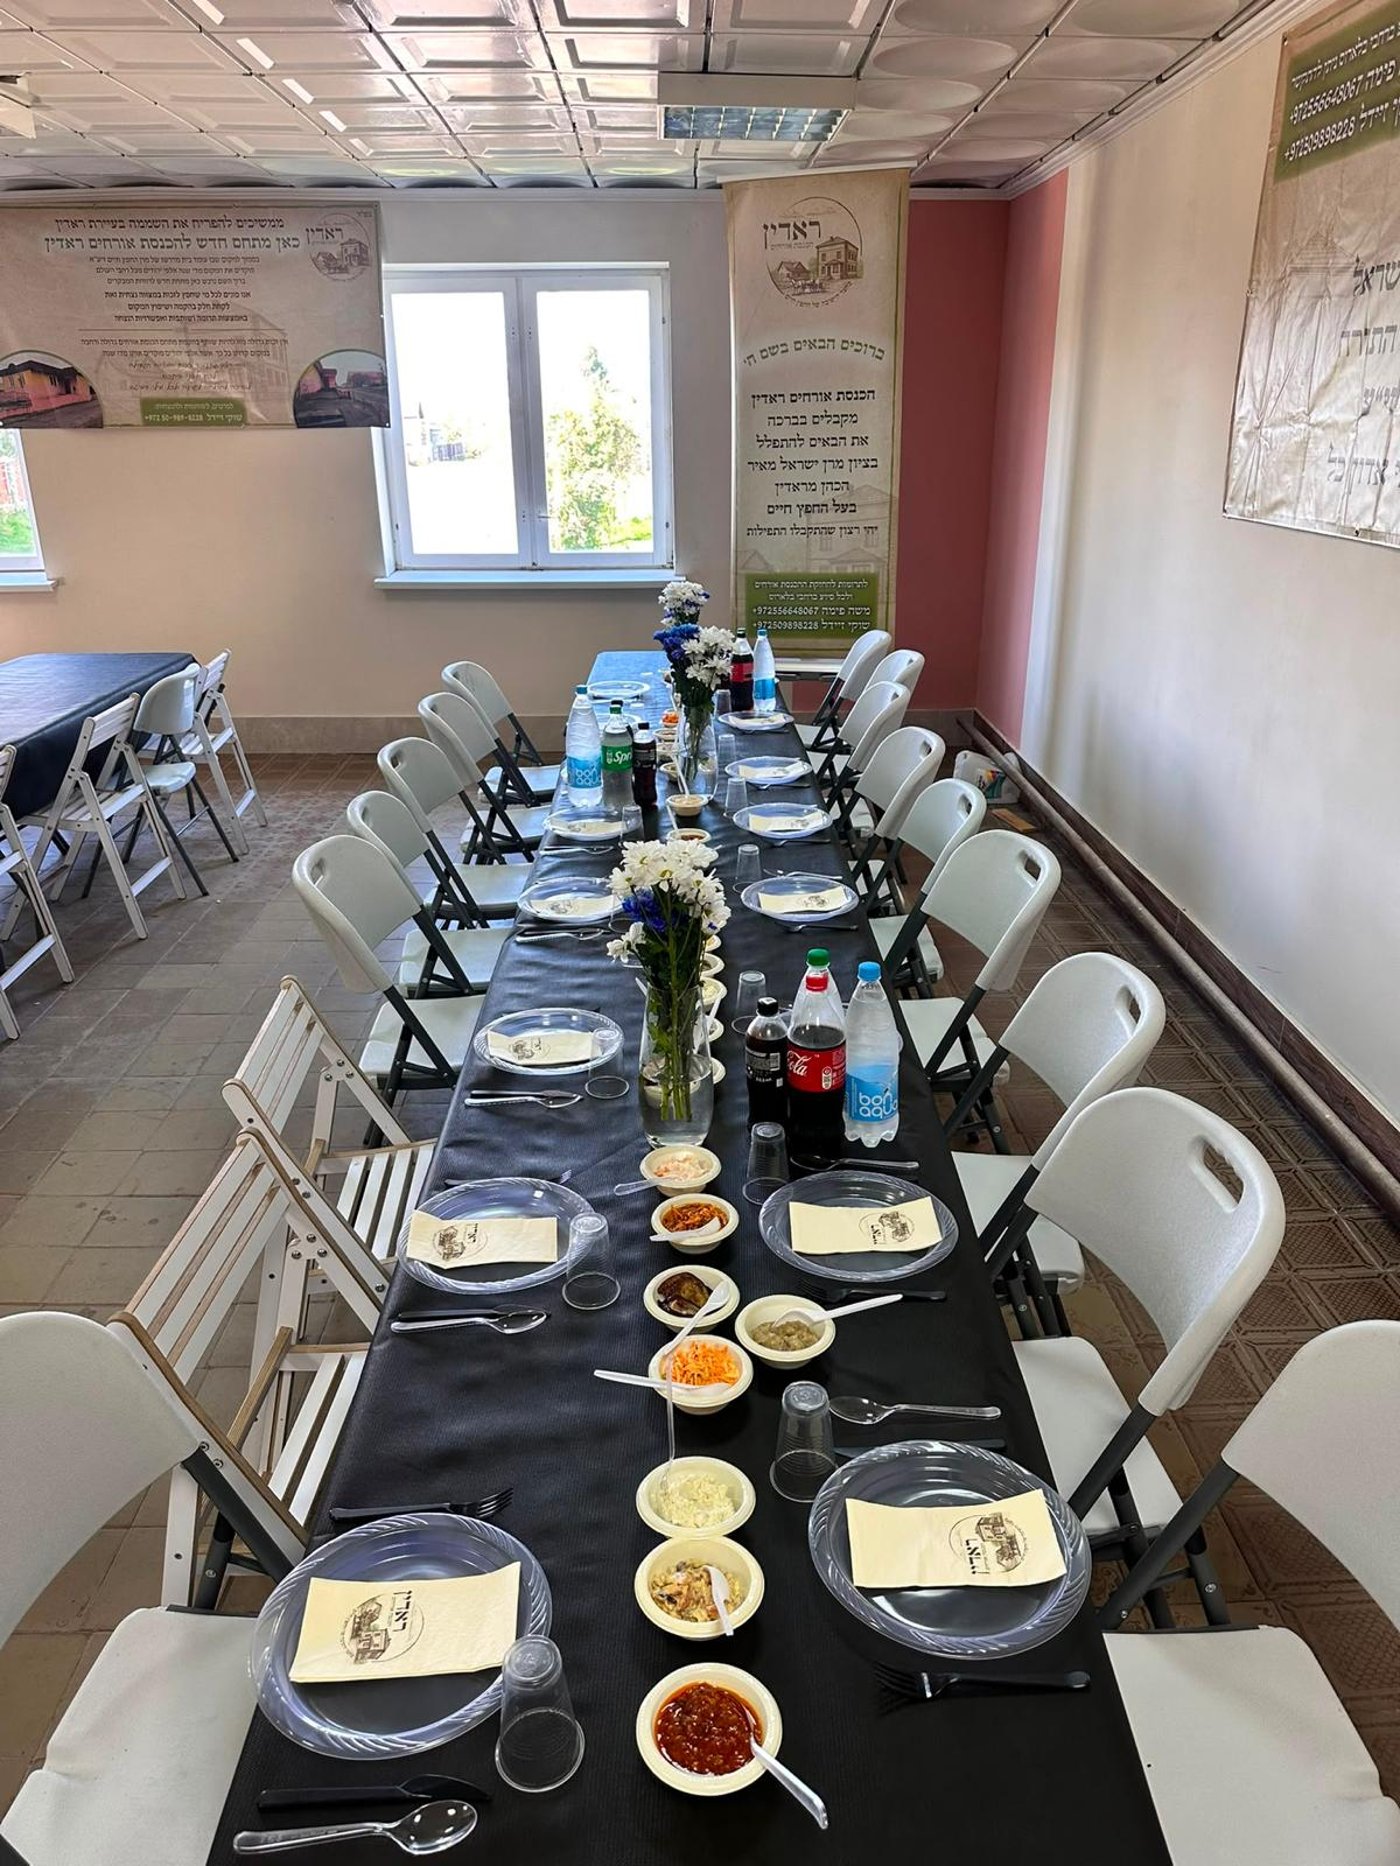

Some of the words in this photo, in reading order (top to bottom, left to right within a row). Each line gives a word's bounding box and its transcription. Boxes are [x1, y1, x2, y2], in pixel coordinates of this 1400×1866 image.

[55, 218, 86, 233] ראדין
[128, 218, 169, 229] השממה
[173, 218, 189, 229] את
[192, 214, 232, 229] להפריח
[236, 218, 284, 229] ממשיכים
[140, 232, 192, 249] להכנסת
[305, 227, 344, 245] ראדין
[762, 219, 822, 250] ראדין
[44, 237, 85, 253] ראדין
[88, 237, 136, 250] אורחים
[196, 237, 228, 249] חדש
[232, 237, 272, 249] מתחם
[275, 237, 300, 253] כאן
[760, 343, 790, 360] בשם
[793, 338, 836, 351] הבאים
[840, 339, 885, 361] ברוכים
[751, 394, 786, 409] ראדין
[790, 391, 832, 403] אורחים
[836, 389, 876, 401] הכנסת
[767, 415, 807, 427] בברכה
[812, 409, 859, 428] מקבלים
[755, 432, 805, 449] להתפלל
[809, 436, 847, 448] הבאים
[851, 436, 869, 447] את
[747, 461, 777, 471] מאיר
[780, 455, 819, 470] ישראל
[823, 458, 845, 473] מרן
[848, 457, 879, 473] בציון
[775, 482, 817, 497] מראדין
[821, 481, 850, 496] הכהן
[767, 504, 793, 515] חיים
[796, 503, 829, 518] החפץ
[832, 498, 857, 514] בעל
[746, 524, 787, 536] התפילות
[838, 526, 861, 538] רצון
[848, 606, 871, 616] משה
[965, 1538, 990, 1575] ראדין
[392, 1590, 413, 1632] ראדין
